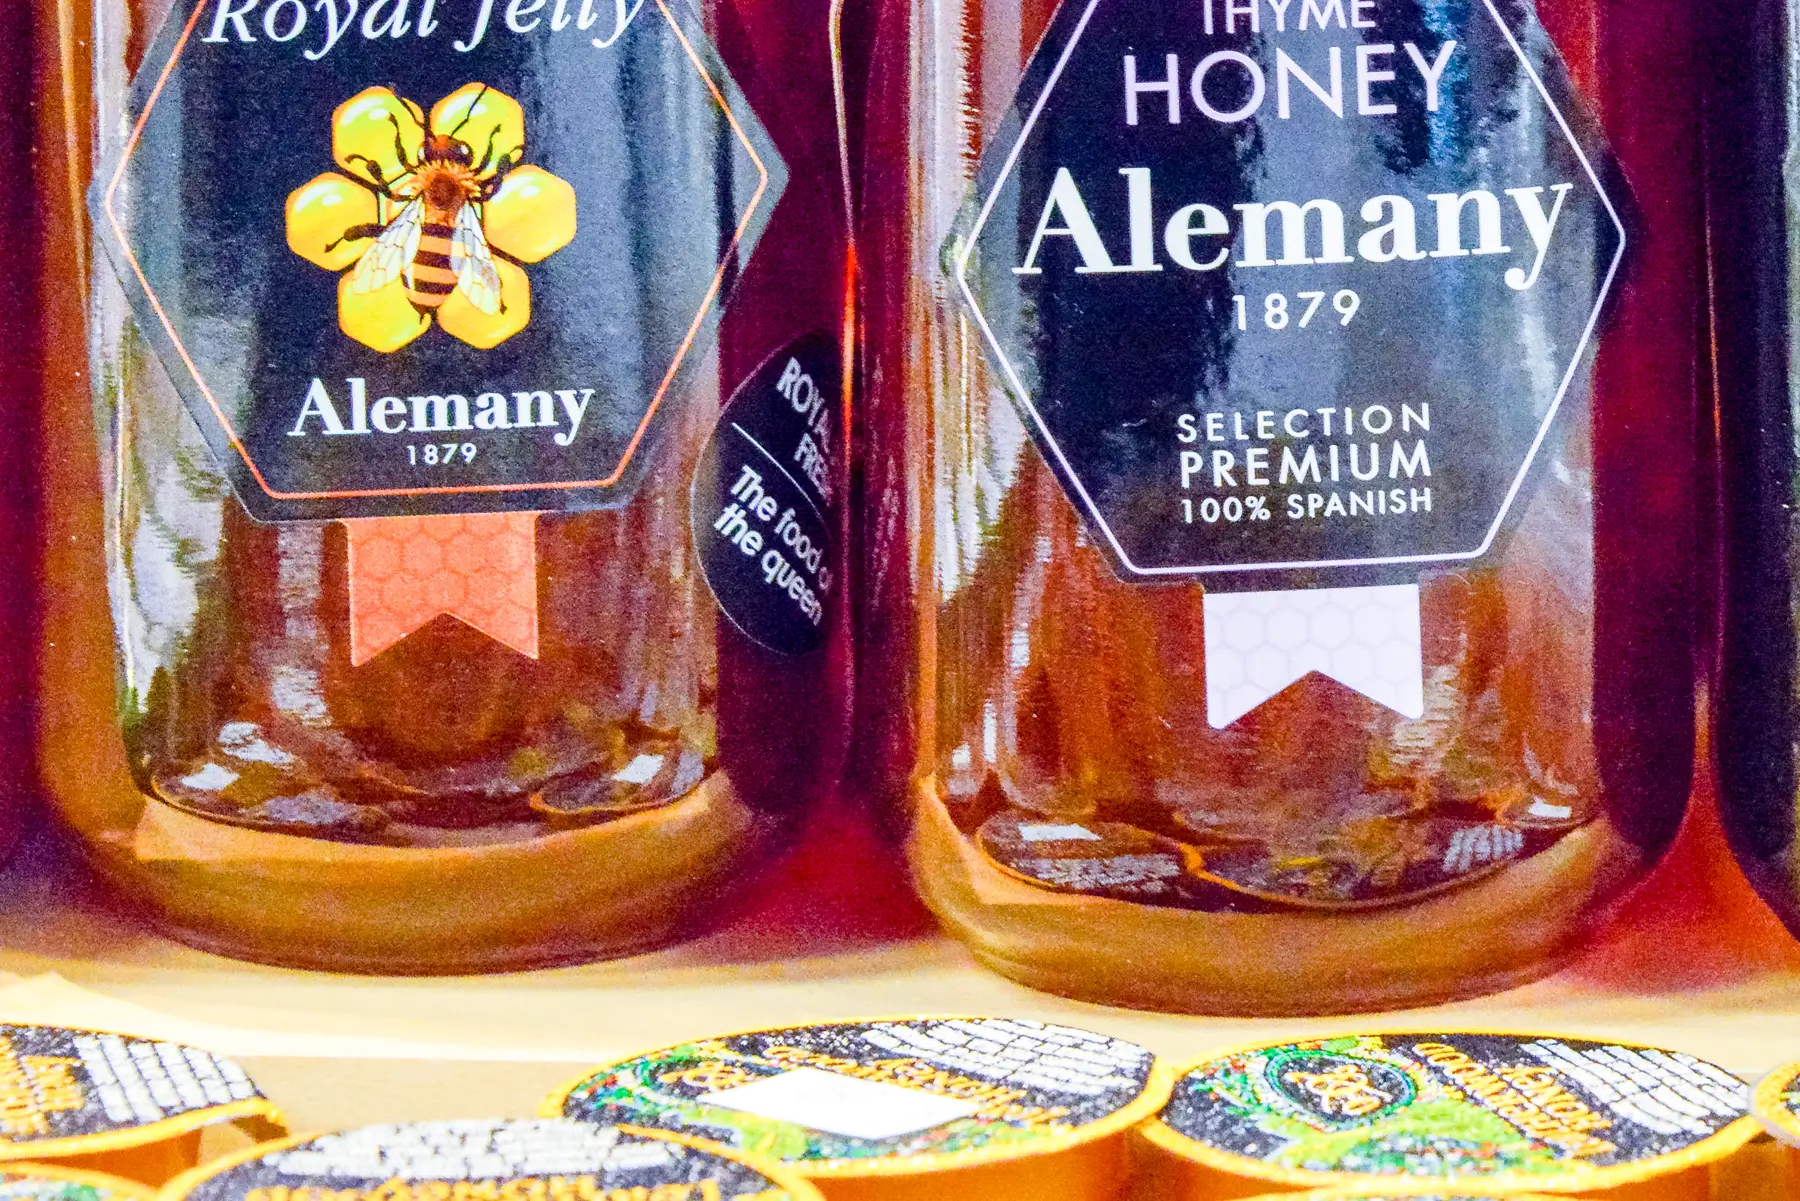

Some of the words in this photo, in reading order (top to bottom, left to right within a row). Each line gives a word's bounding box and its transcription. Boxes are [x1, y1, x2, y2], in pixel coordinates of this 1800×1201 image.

[1123, 39, 1458, 126] HONEY
[1011, 166, 1573, 290] Alemany
[1232, 288, 1361, 331] 1879
[287, 377, 595, 446] Alemany
[1177, 402, 1431, 443] SELECTION
[405, 442, 477, 467] 1879
[1180, 440, 1432, 489] PREMIUM
[730, 464, 778, 522] The
[774, 507, 823, 574] food
[1181, 495, 1271, 524] 100%
[1287, 487, 1432, 521] SPANISH
[714, 503, 763, 556] the
[761, 549, 823, 626] queen
